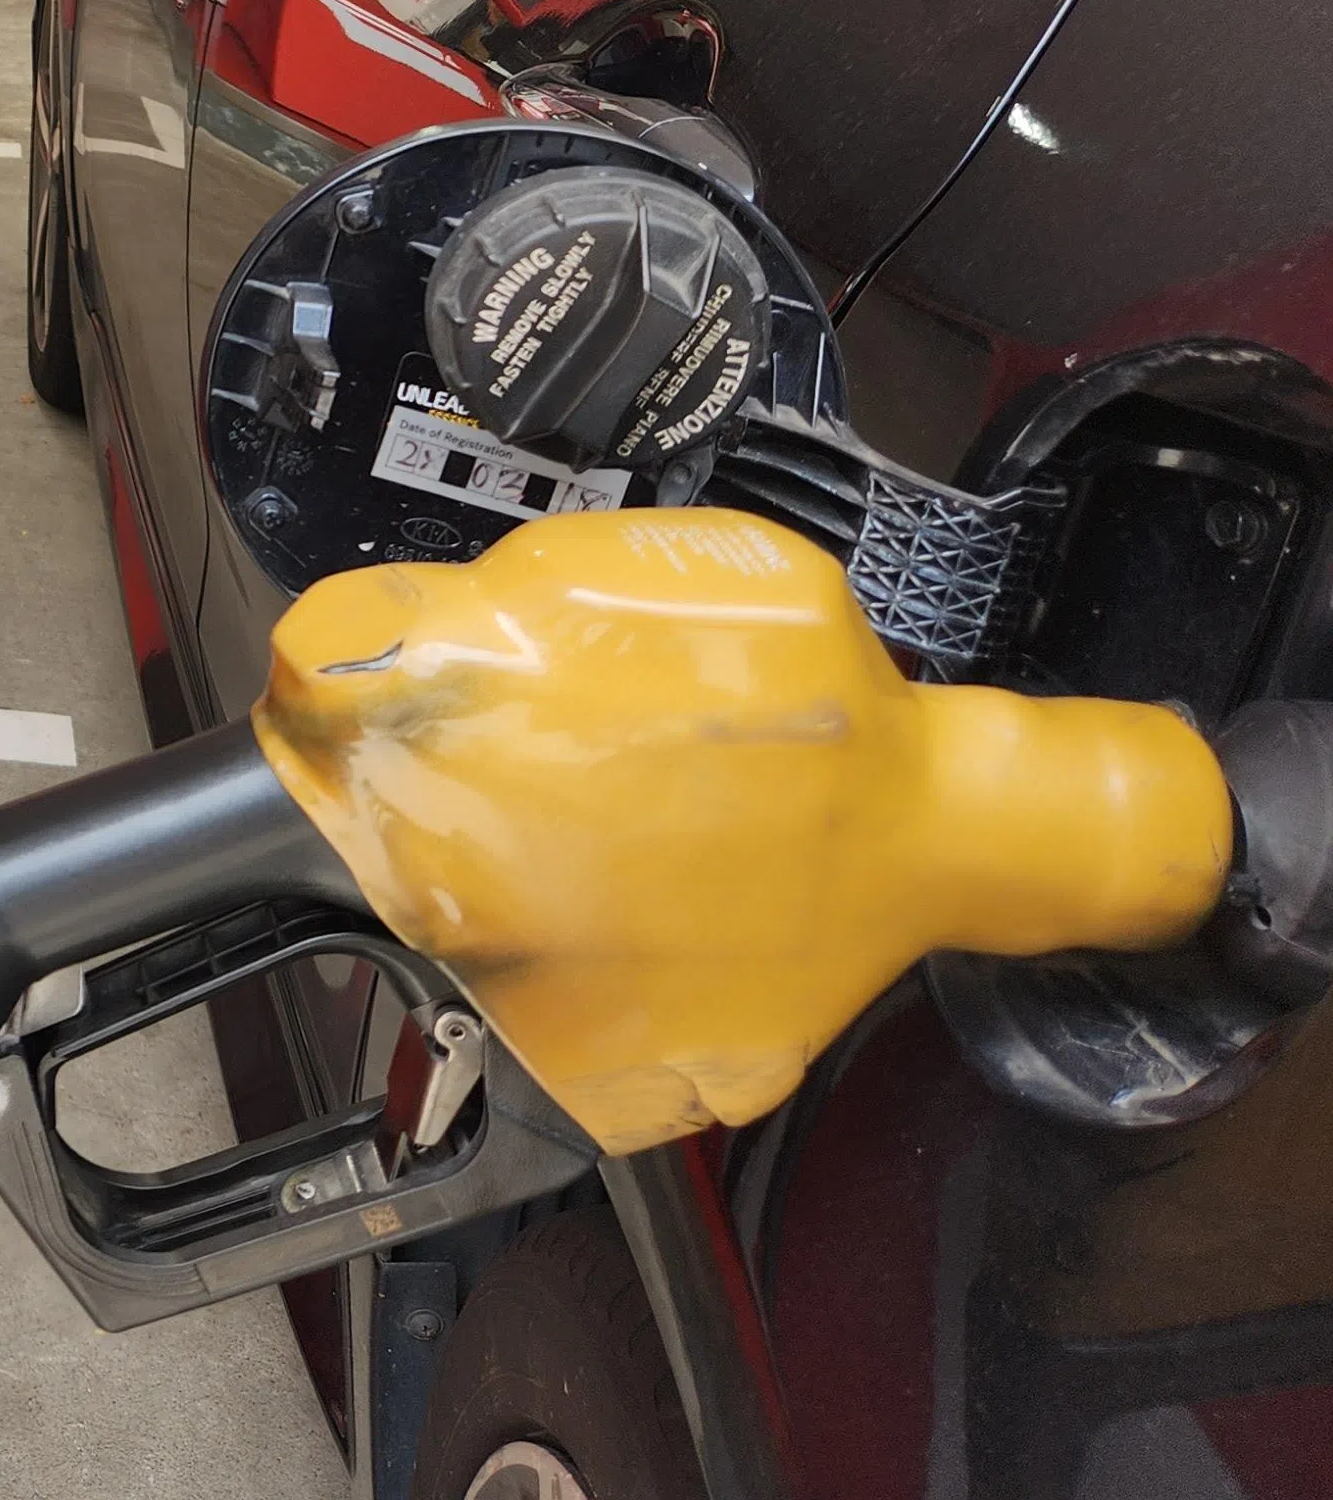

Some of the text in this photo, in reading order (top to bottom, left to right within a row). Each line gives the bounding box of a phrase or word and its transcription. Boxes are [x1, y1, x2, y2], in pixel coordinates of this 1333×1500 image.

[472, 245, 555, 344] WARNING
[488, 265, 595, 399] FASTEN TIGHTLY
[490, 230, 596, 365] REMOVE SLOWLY
[399, 418, 515, 461] Date of Registration
[615, 410, 660, 458] PIANO
[654, 336, 752, 451] ATTENZIONE
